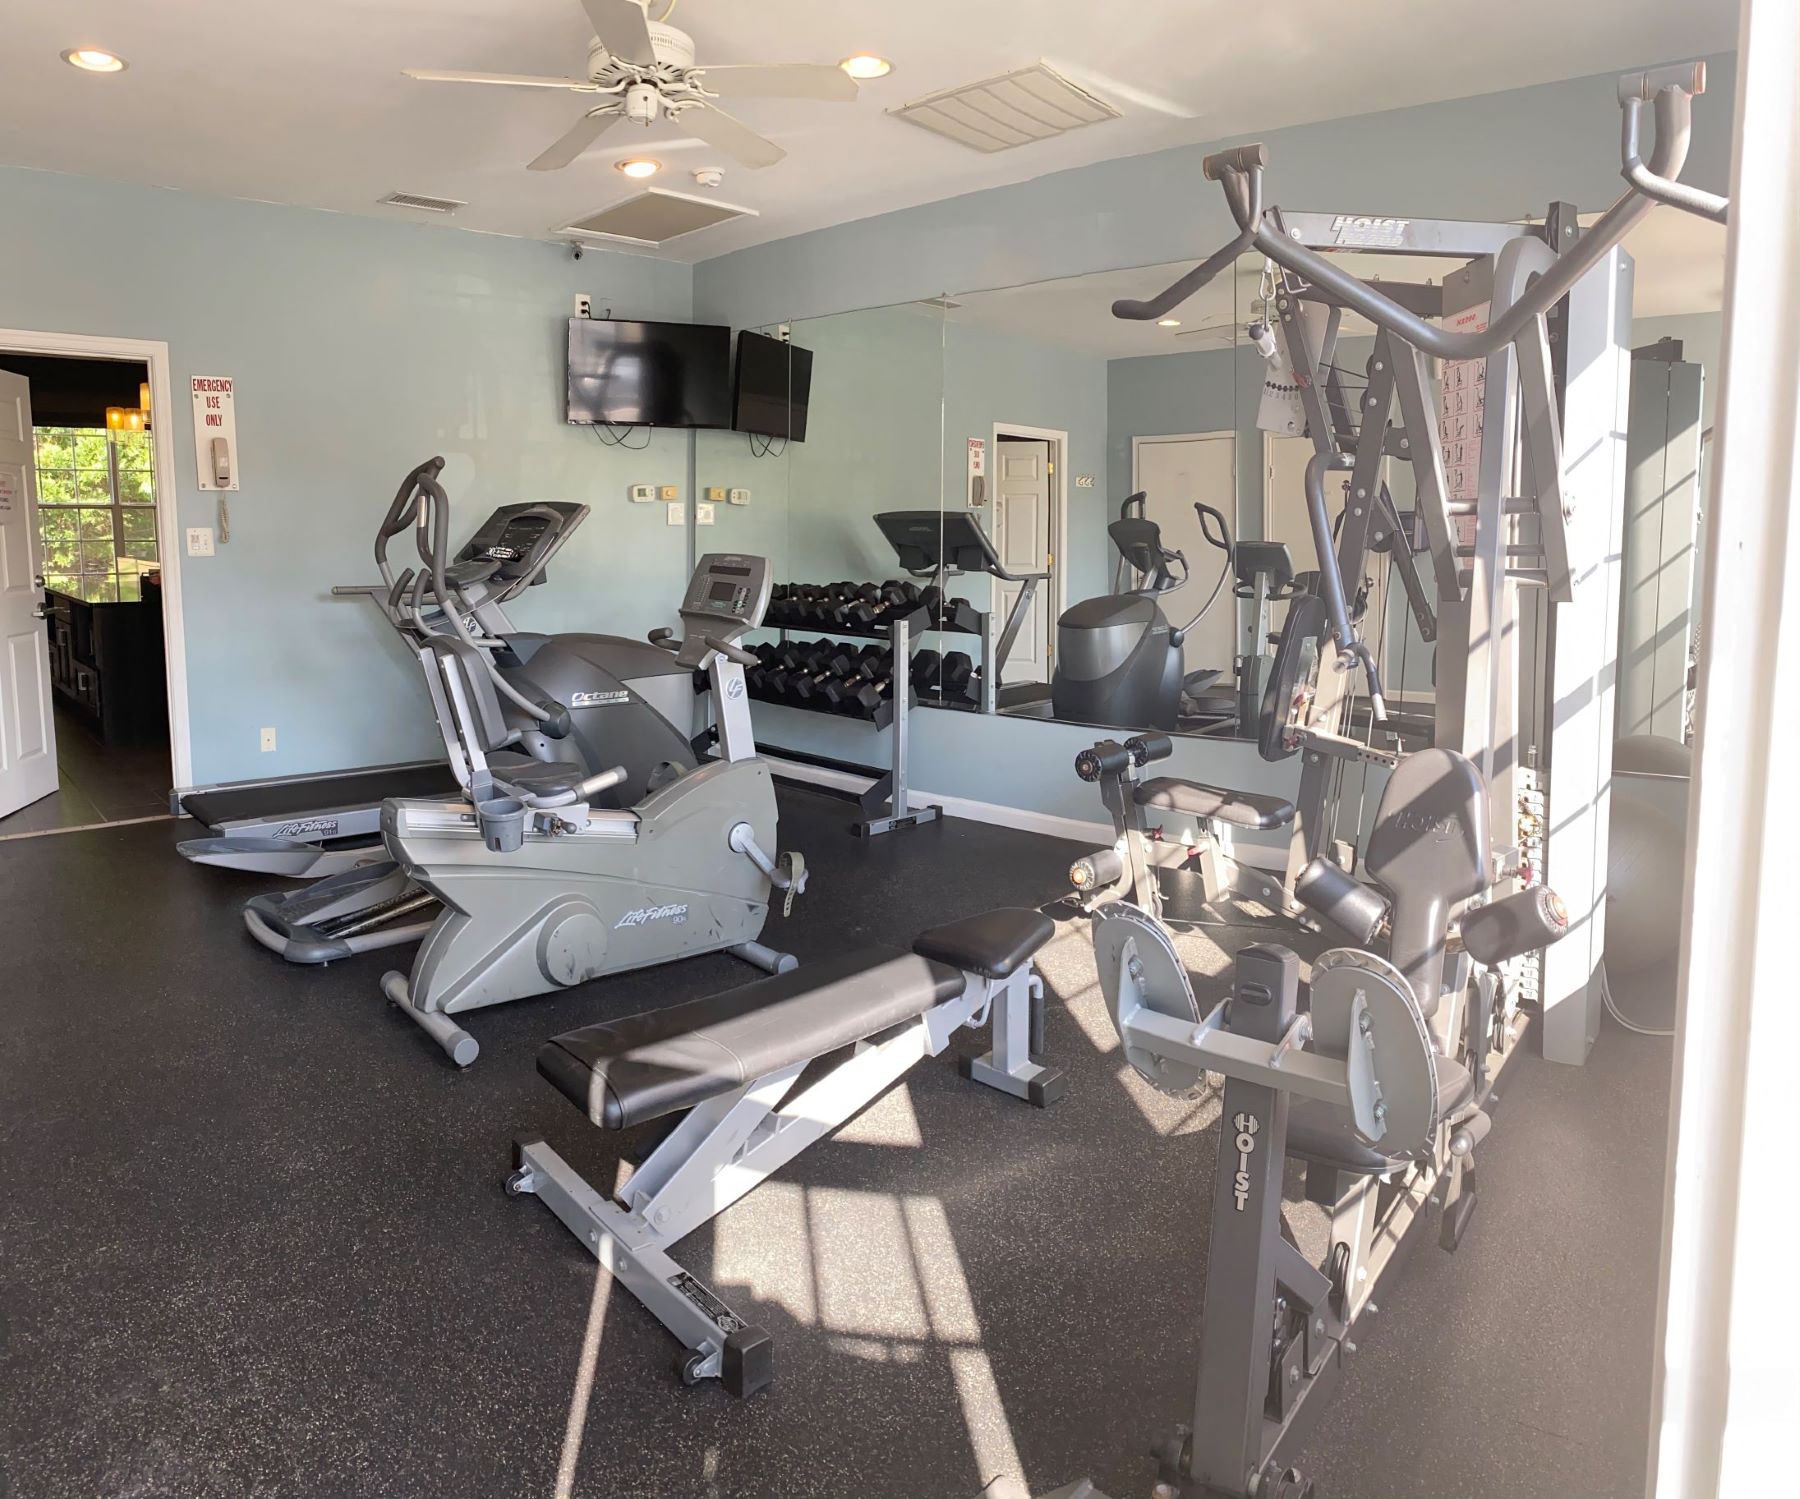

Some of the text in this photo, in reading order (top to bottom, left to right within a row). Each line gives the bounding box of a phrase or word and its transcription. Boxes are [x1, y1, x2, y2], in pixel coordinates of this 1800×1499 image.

[192, 378, 233, 393] EMERGENCY
[206, 396, 220, 409] USE
[206, 414, 223, 427] ONLY
[571, 690, 628, 701] Octane
[1233, 1112, 1260, 1211] HOIST
